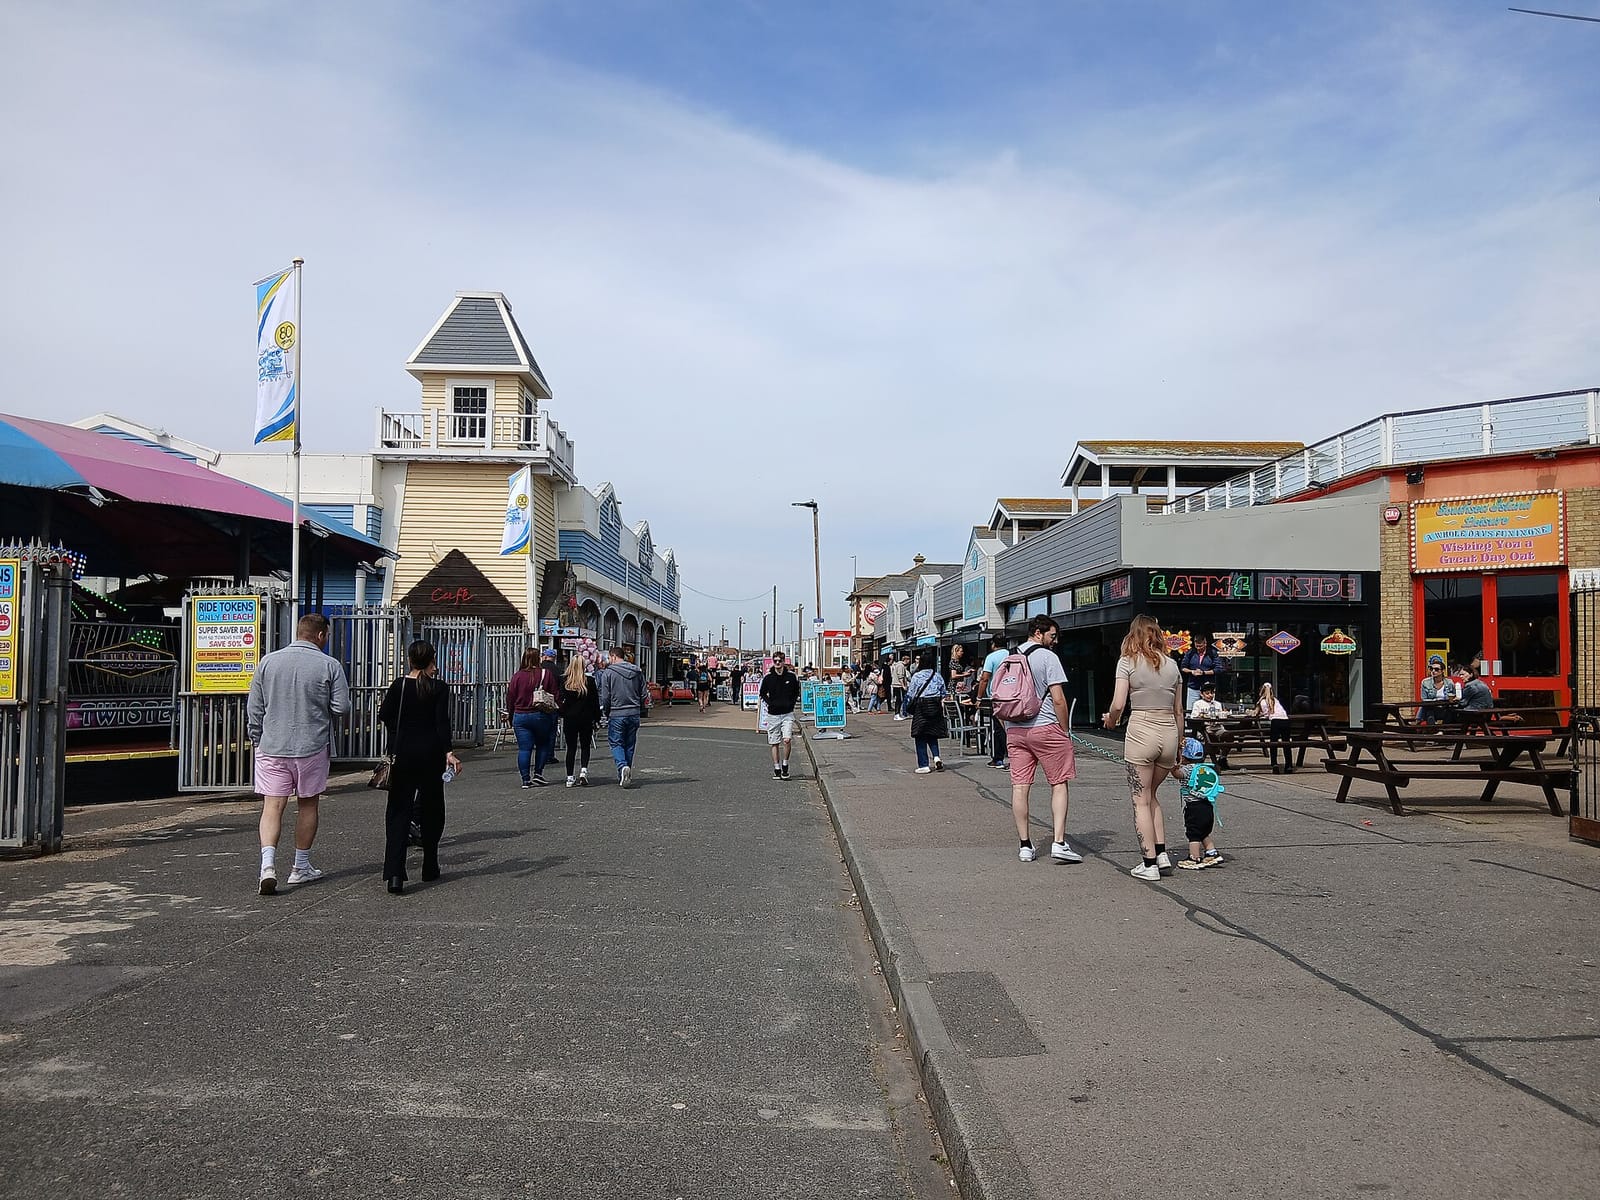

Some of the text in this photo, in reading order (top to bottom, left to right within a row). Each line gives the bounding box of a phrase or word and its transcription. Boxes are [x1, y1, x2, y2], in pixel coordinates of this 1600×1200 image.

[279, 326, 293, 340] 80
[1461, 515, 1509, 528] Leisure
[1435, 530, 1465, 540] WHOLE
[1468, 530, 1492, 538] DAYS
[1527, 526, 1547, 536] ONE
[1440, 539, 1534, 553] Wishing You a
[1440, 550, 1535, 565] Great Day Out
[1170, 575, 1231, 596] ATM
[1263, 576, 1356, 599] INSIDE
[431, 587, 476, 606] Café
[198, 602, 253, 612] RIDE TOKENS
[198, 613, 253, 621] ONLY £1 EACH
[198, 626, 253, 634] SUPER SAVER BAG
[1321, 642, 1356, 651] PUSHERS
[744, 682, 758, 692] ATM
